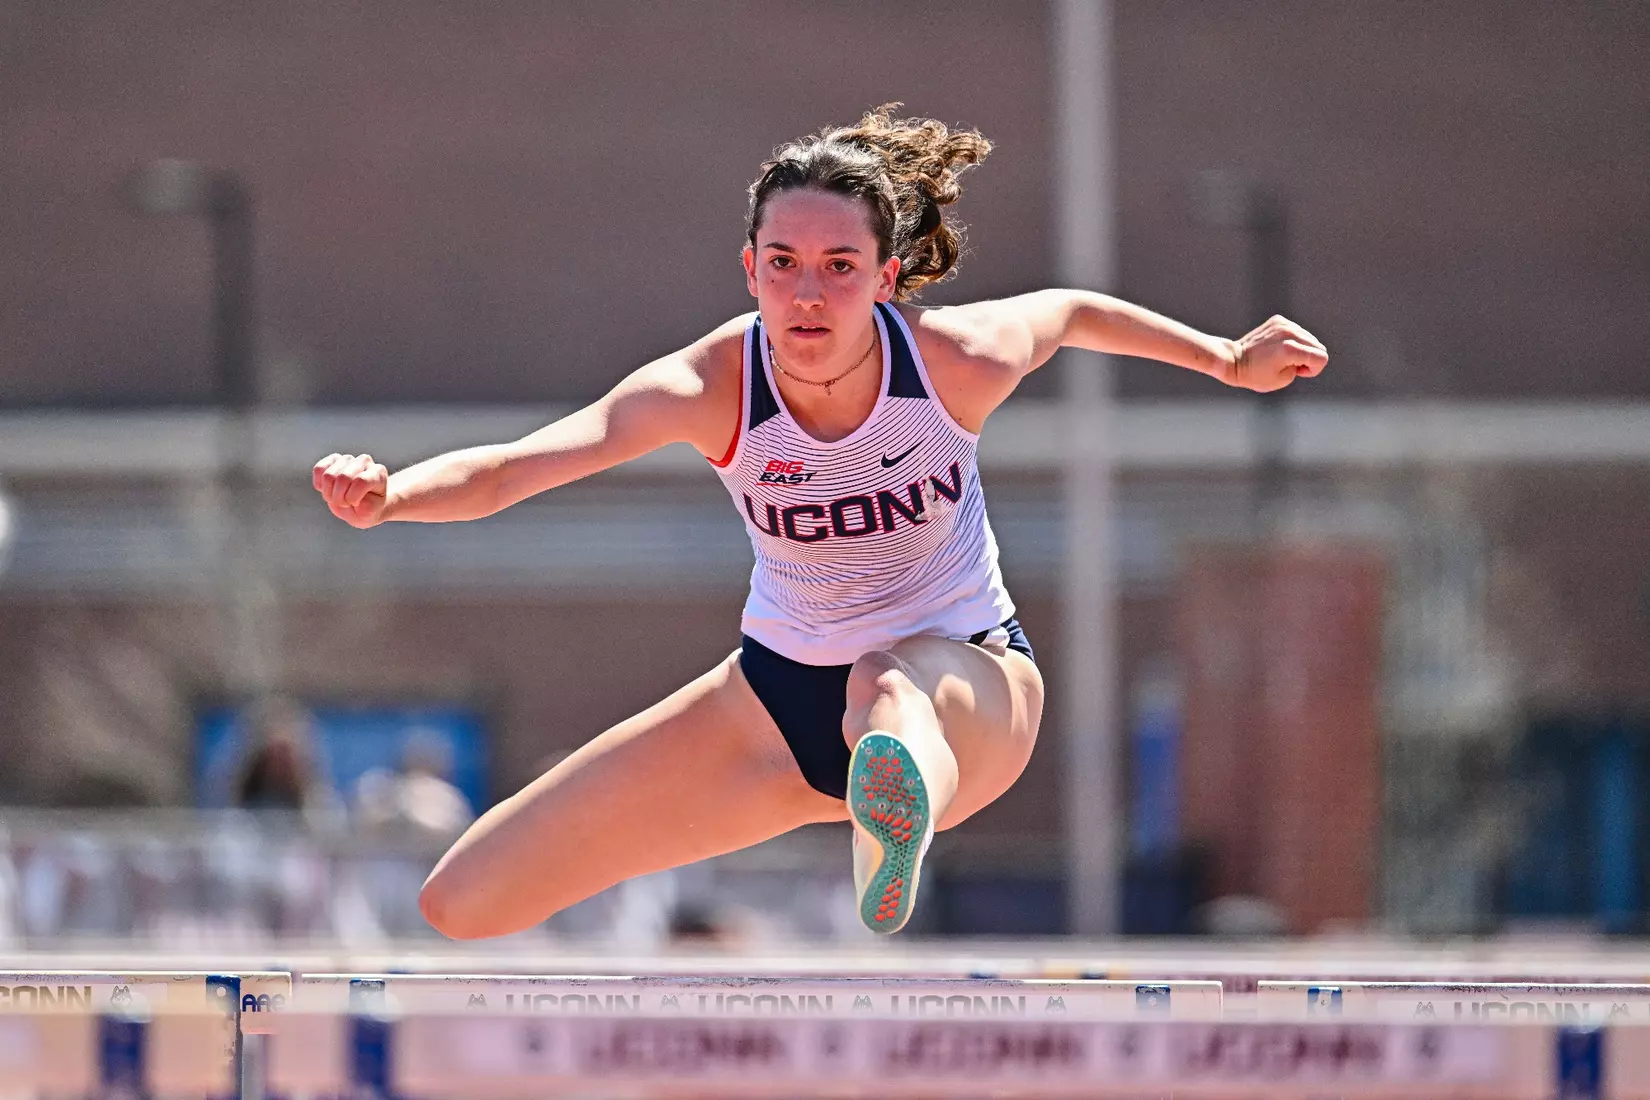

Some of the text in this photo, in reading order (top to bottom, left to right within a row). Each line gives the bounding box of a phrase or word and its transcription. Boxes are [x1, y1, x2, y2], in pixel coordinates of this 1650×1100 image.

[765, 460, 804, 474] BIG
[759, 472, 817, 484] EAST
[743, 461, 962, 543] UCONN
